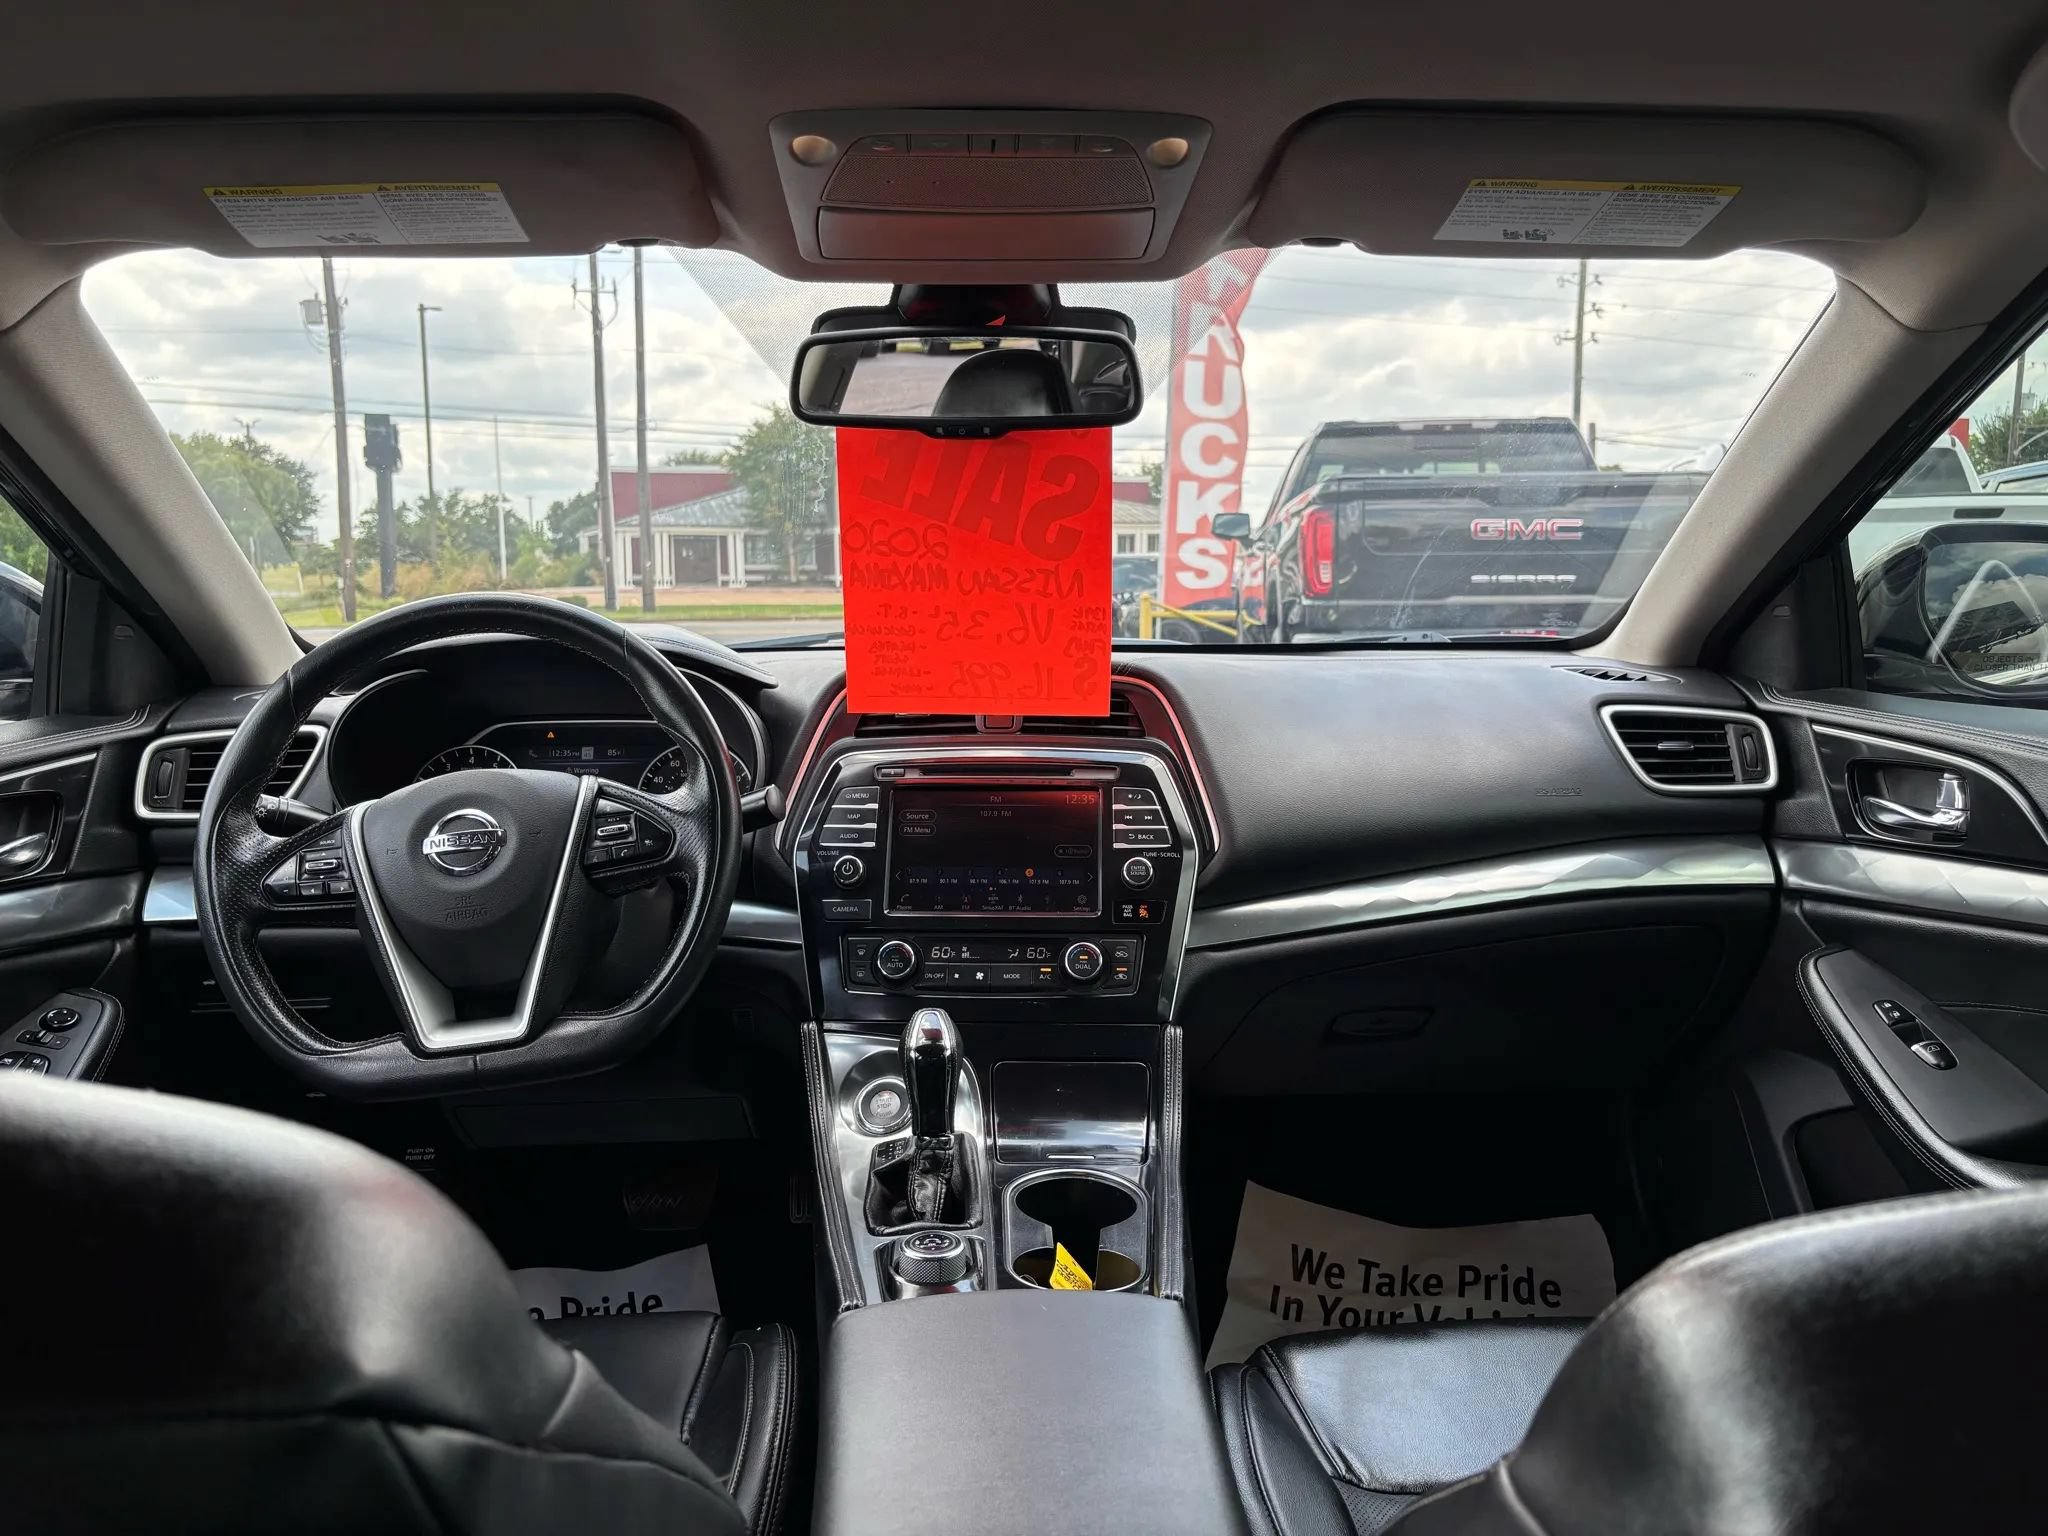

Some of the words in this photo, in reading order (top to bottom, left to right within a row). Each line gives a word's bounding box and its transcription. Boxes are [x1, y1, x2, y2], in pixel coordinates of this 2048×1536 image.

[229, 188, 283, 196] WARNING
[1471, 518, 1585, 541] GMC
[1471, 574, 1577, 584] SIERRA
[468, 756, 475, 765] 4
[669, 760, 680, 768] 60
[445, 764, 451, 772] 3
[653, 776, 664, 784] 40
[1065, 794, 1095, 805] 12:35
[906, 812, 929, 820] Source
[430, 832, 497, 850] NISSAN
[1291, 1243, 1345, 1290] We
[1357, 1258, 1443, 1298] Take
[1458, 1263, 1562, 1309] Pride
[1270, 1284, 1305, 1323] In
[1317, 1294, 1404, 1329] Your
